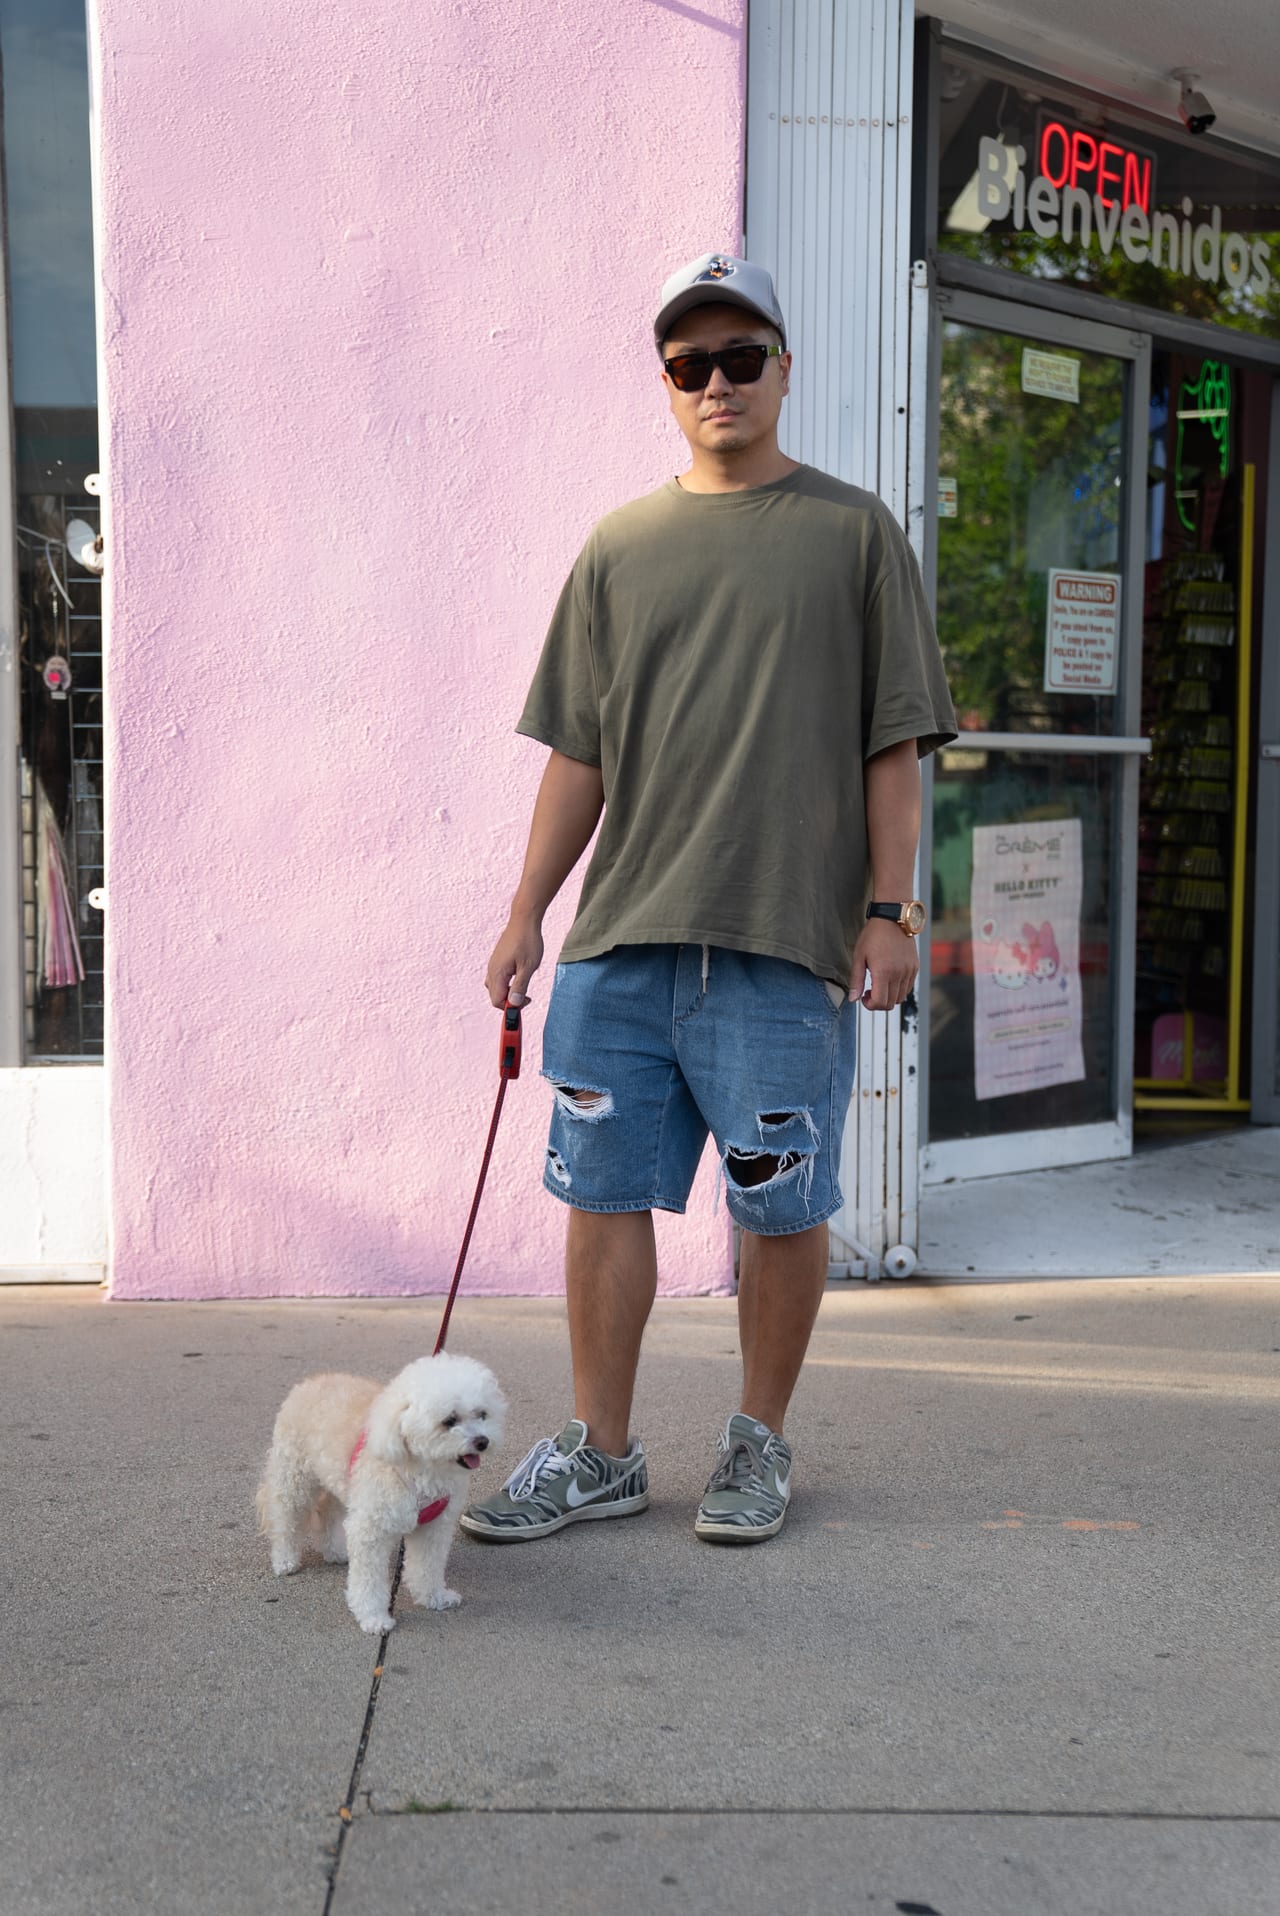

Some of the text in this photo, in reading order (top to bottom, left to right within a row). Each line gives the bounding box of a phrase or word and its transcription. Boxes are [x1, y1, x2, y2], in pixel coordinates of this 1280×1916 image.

[1040, 122, 1152, 215] OPEN
[978, 136, 1273, 294] Bienvenidos
[1059, 581, 1112, 601] WARNING
[1060, 623, 1071, 632] you
[1090, 623, 1103, 633] from
[1067, 637, 1082, 646] copy
[1083, 638, 1098, 647] goes
[1054, 647, 1076, 658] POLICE
[1090, 652, 1104, 661] copy
[1072, 662, 1093, 671] posted
[1063, 673, 1102, 684] Social Media
[994, 876, 1059, 893] HELLO KITTY
